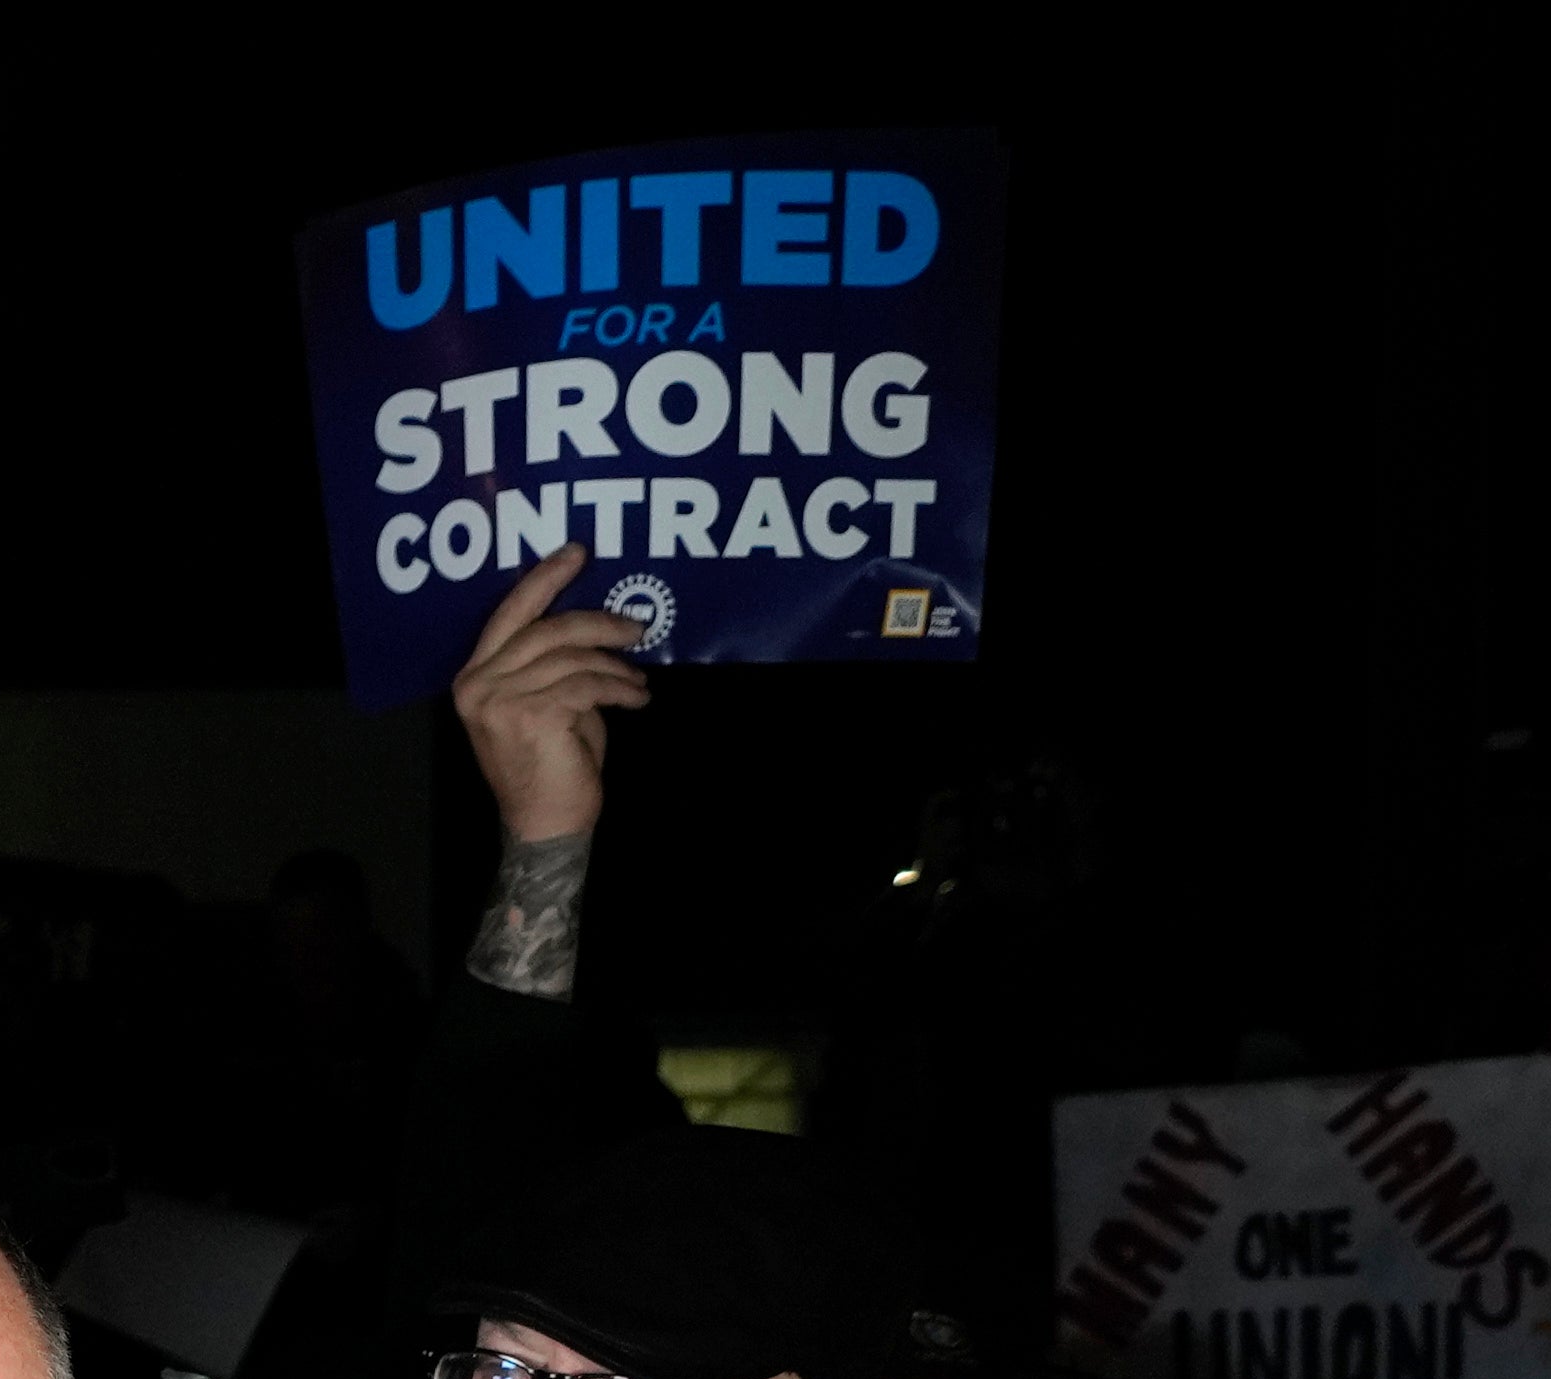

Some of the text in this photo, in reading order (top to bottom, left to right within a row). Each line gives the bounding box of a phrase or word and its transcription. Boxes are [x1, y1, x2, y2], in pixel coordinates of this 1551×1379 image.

[366, 169, 942, 332] UNITED
[557, 301, 727, 352] FOR A
[373, 348, 931, 495] STRONG
[374, 476, 938, 596] CONTRACT
[1050, 1068, 1550, 1348] MANY HANDS
[1235, 1206, 1359, 1280] ONE
